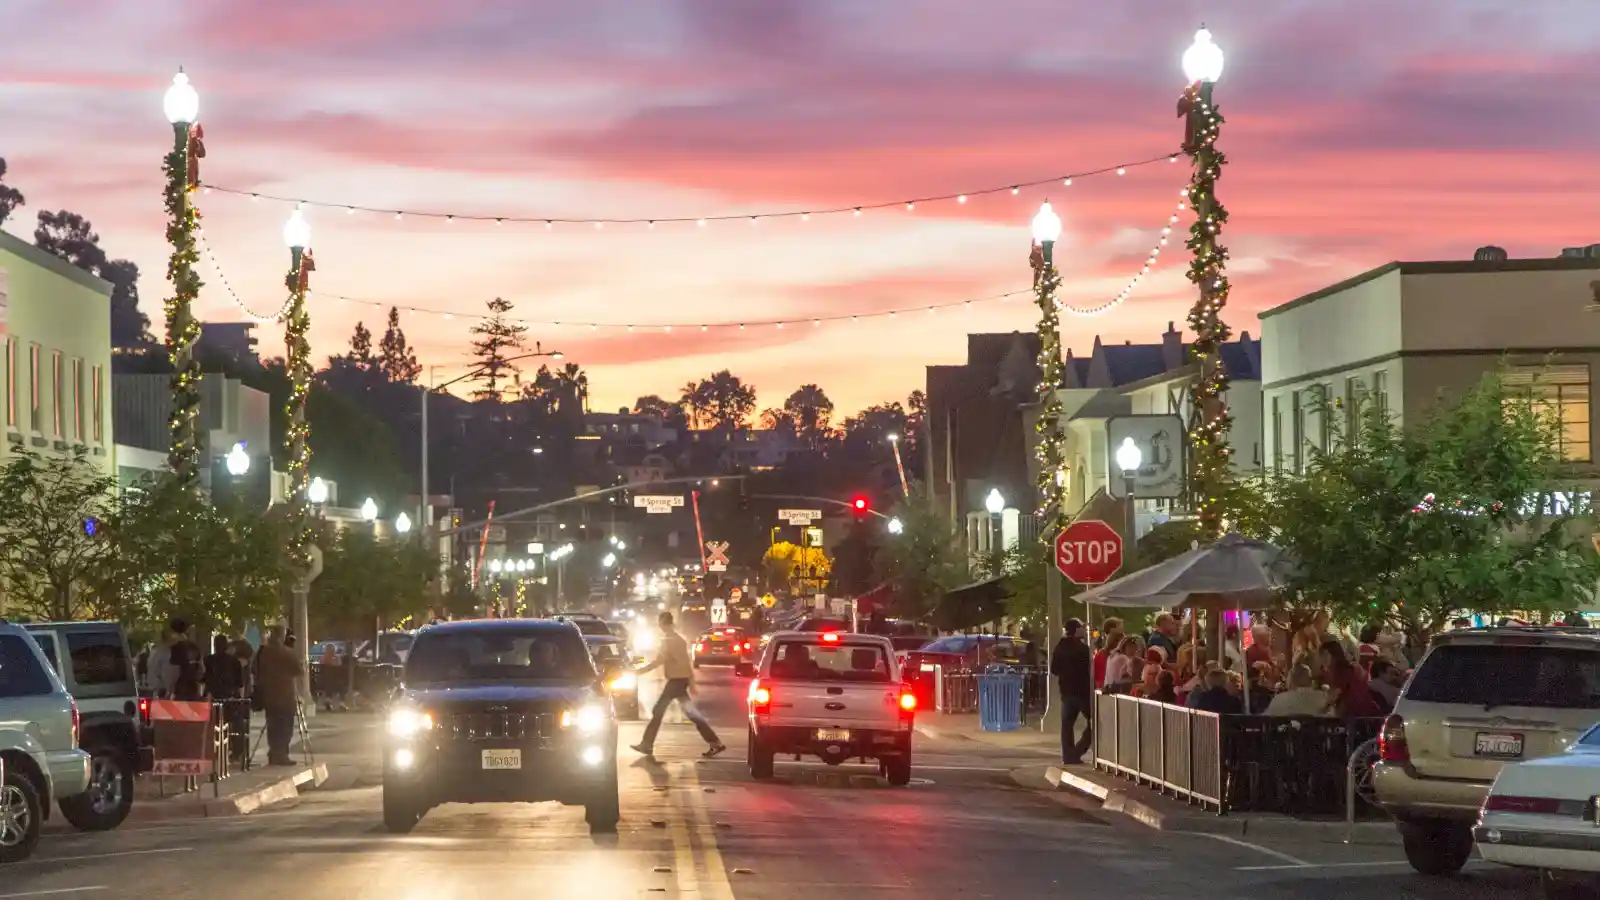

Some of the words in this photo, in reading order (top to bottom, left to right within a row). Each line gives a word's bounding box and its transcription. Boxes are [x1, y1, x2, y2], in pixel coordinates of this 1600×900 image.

[646, 497, 671, 506] Spring
[673, 497, 682, 505] St
[789, 511, 810, 519] Spring
[1060, 540, 1117, 565] STOP
